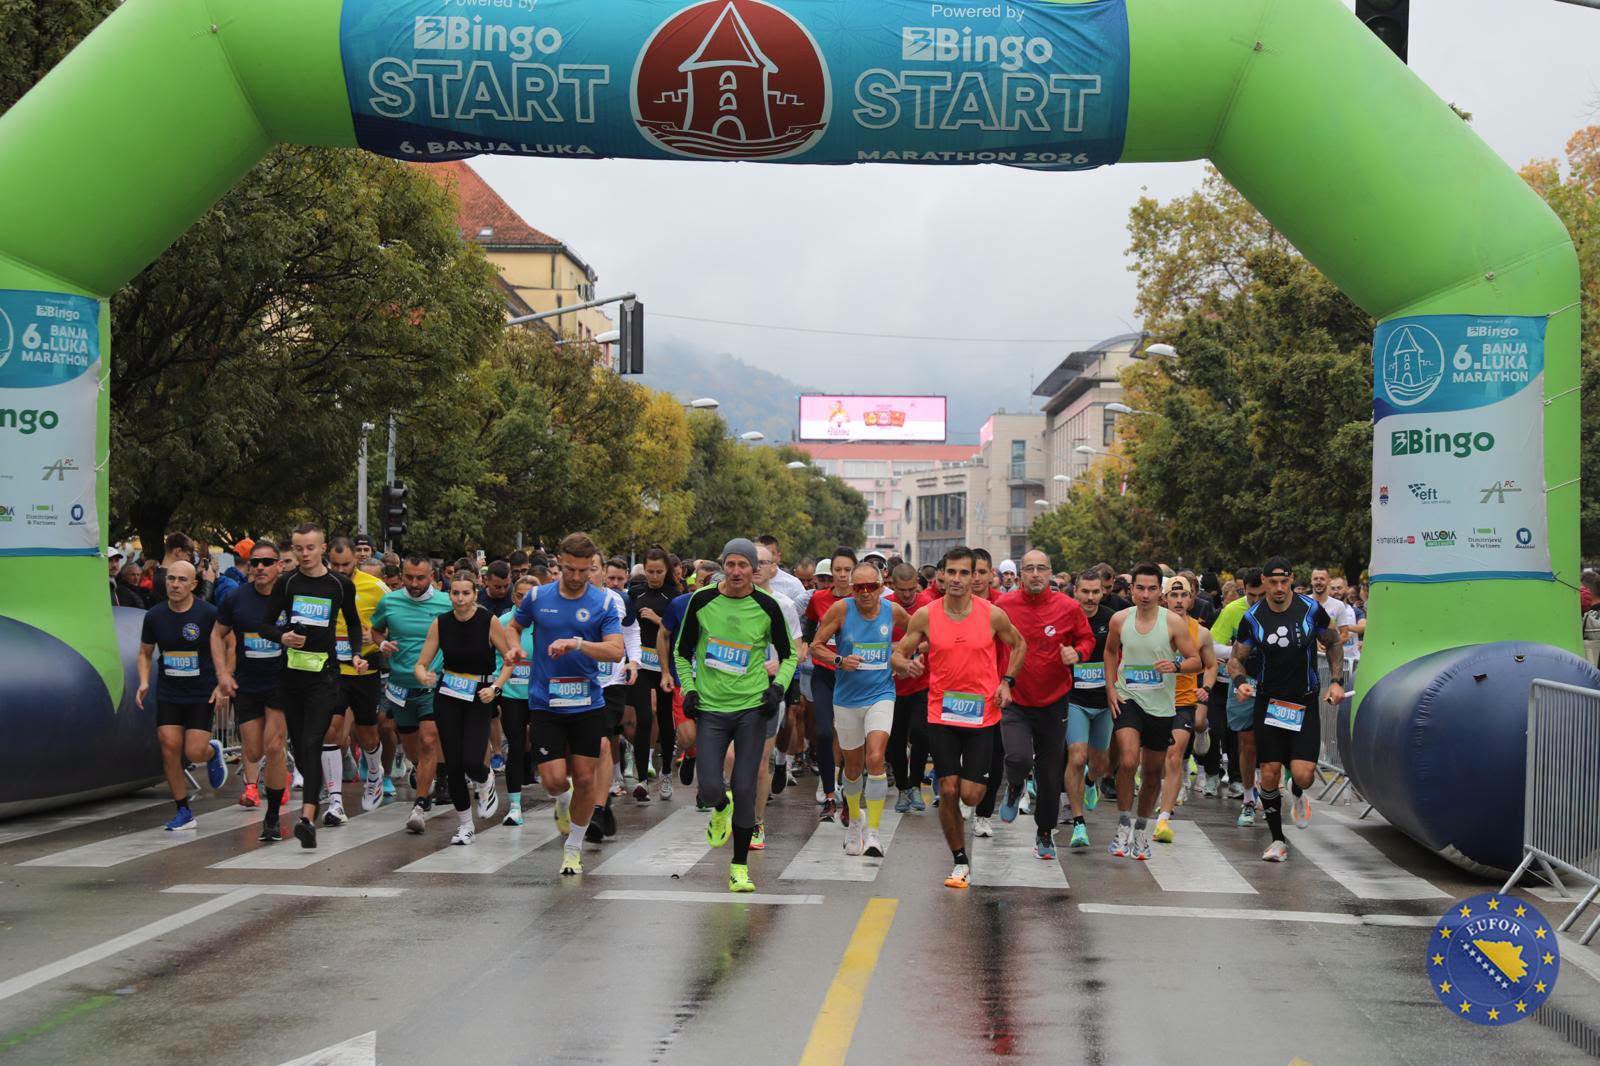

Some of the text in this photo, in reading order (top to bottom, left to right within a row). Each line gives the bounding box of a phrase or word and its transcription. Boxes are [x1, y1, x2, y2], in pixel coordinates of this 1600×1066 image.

[444, 0, 512, 8] owered
[931, 4, 1025, 21] Powered by
[447, 14, 562, 61] Bingo
[936, 26, 1053, 70] Bingo
[368, 56, 610, 124] START
[852, 67, 1101, 132] START
[400, 141, 596, 154] 6. BANJA LUKA
[857, 150, 1089, 164] MARATHON 2026
[47, 306, 80, 321] Bingo
[22, 322, 50, 350] 6.
[50, 325, 88, 340] BANJA
[1478, 325, 1519, 338] Bingo
[49, 337, 88, 354] LUKA
[1482, 343, 1528, 355] BANJA
[21, 350, 88, 366] MARATHON
[1453, 344, 1481, 371] 6.
[1482, 355, 1528, 370] LUKA
[1452, 371, 1529, 383] MARATHON
[1409, 427, 1495, 458] Bingo
[302, 604, 323, 616] 2070
[717, 645, 740, 662] 1151
[515, 665, 531, 676] 300
[1081, 668, 1103, 680] 2062
[951, 700, 975, 713] 2077
[1275, 705, 1296, 720] 3016
